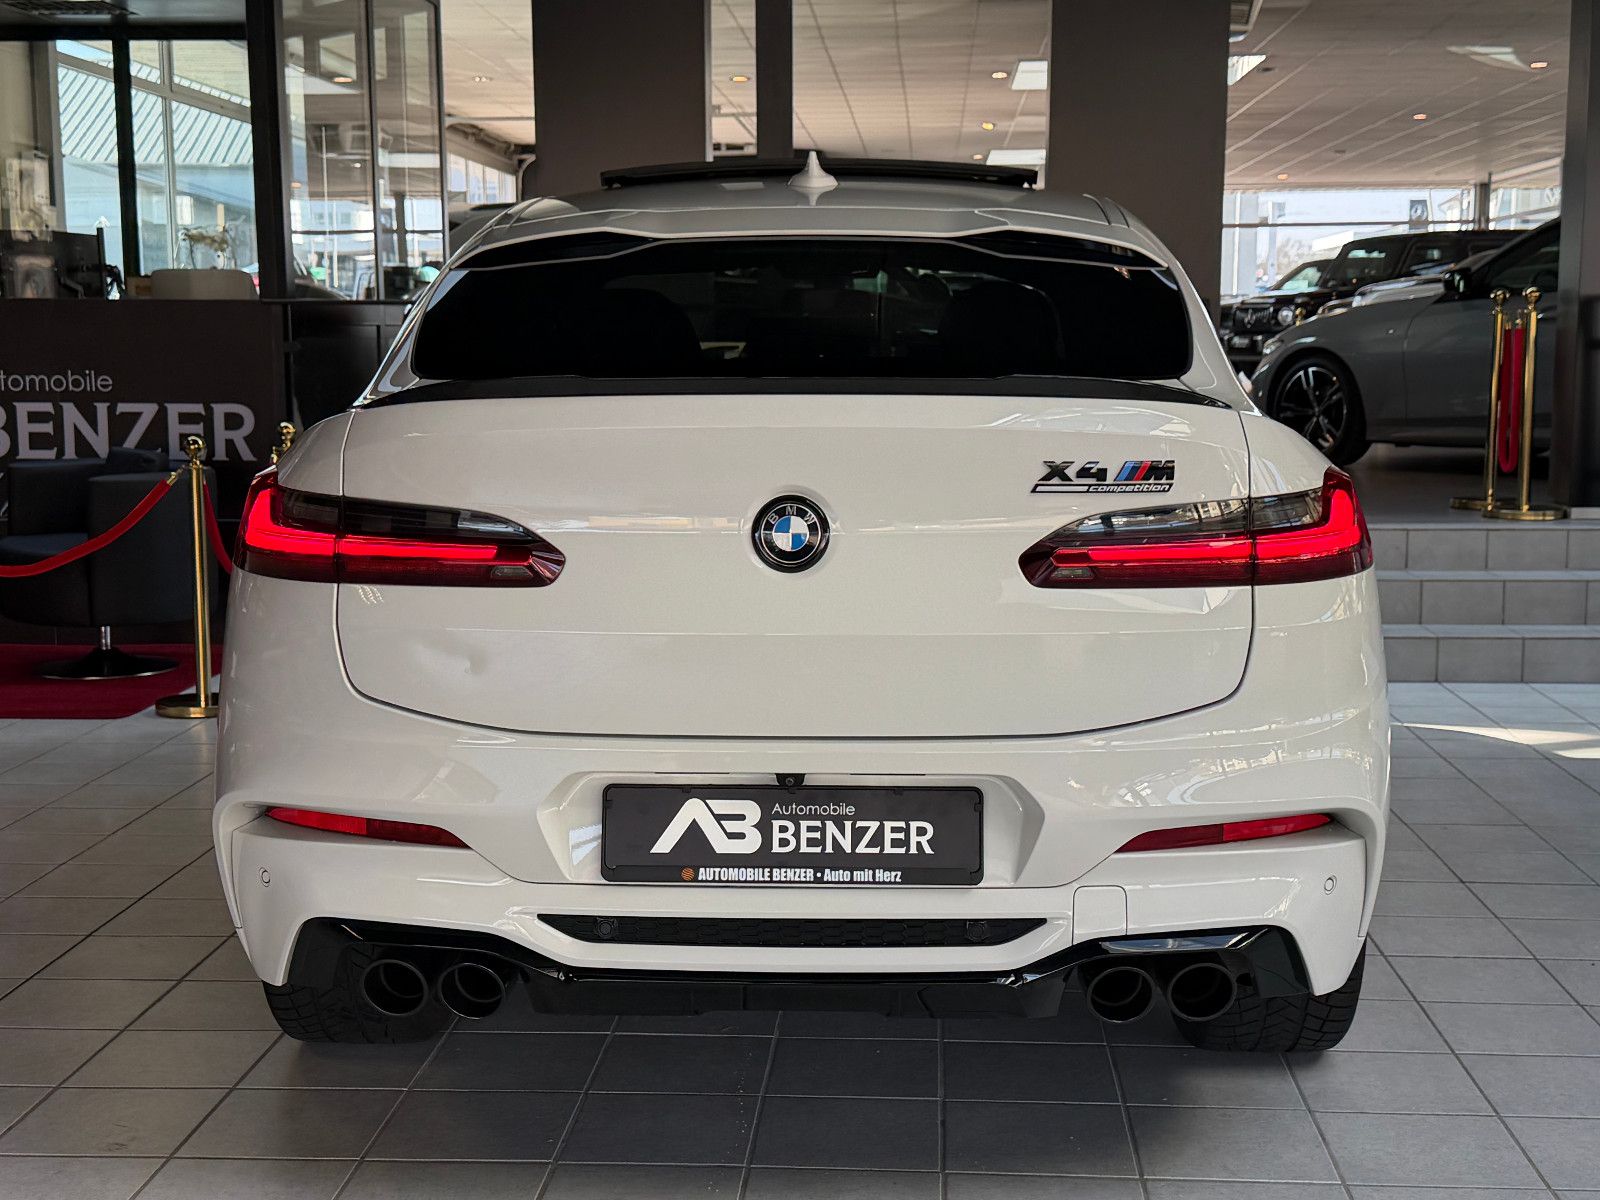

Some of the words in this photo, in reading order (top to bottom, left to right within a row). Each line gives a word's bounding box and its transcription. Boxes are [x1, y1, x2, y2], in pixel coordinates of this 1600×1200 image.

[0, 401, 258, 461] ENZER
[1038, 461, 1108, 482] X4
[1088, 484, 1170, 493] competition
[768, 504, 816, 525] BMW
[771, 802, 856, 816] Automobile
[771, 819, 935, 854] BENZER
[698, 867, 771, 881] AUTOMOBILE
[772, 867, 814, 882] BENZER
[823, 868, 850, 882] Auto
[853, 868, 873, 882] mit
[875, 868, 902, 883] Herz
